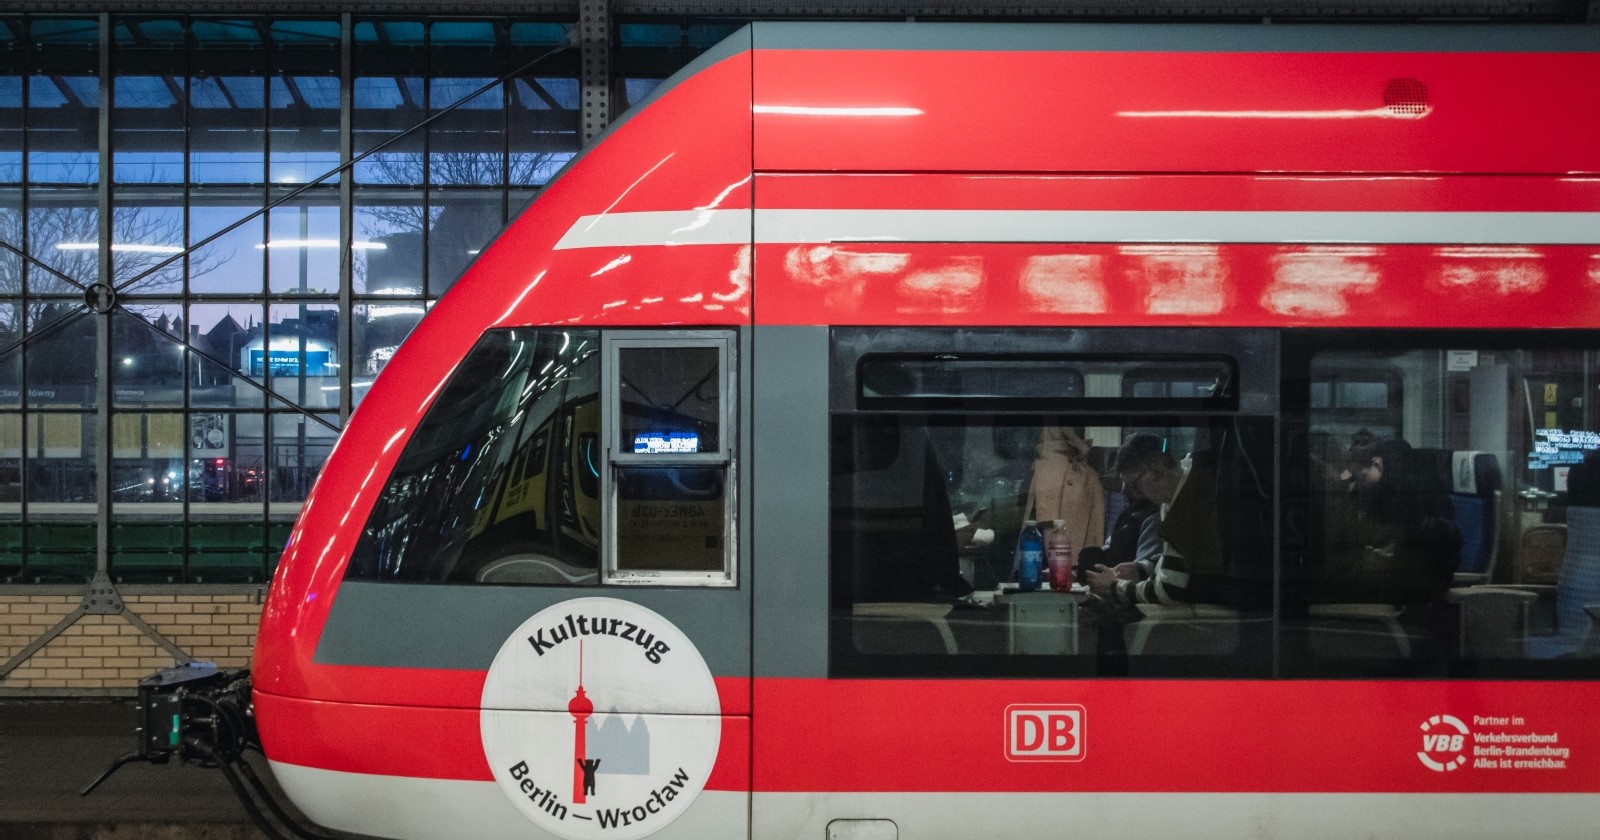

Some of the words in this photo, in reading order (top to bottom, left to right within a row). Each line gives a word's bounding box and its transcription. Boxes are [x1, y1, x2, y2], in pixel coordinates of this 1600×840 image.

[28, 388, 56, 398] łówny
[527, 614, 671, 665] Kulturzug
[1473, 715, 1509, 725] Partner
[1512, 715, 1524, 725] im
[1016, 714, 1076, 752] DB
[1473, 733, 1557, 743] Verkehrsverbund
[1423, 734, 1464, 752] VBB
[1473, 746, 1569, 758] Berlin-Brandenburg
[1473, 758, 1498, 768] Alles
[1500, 758, 1512, 768] ist
[1514, 758, 1566, 768] erreichbar.
[509, 760, 568, 820] Berlin
[596, 767, 690, 829] Wrocław
